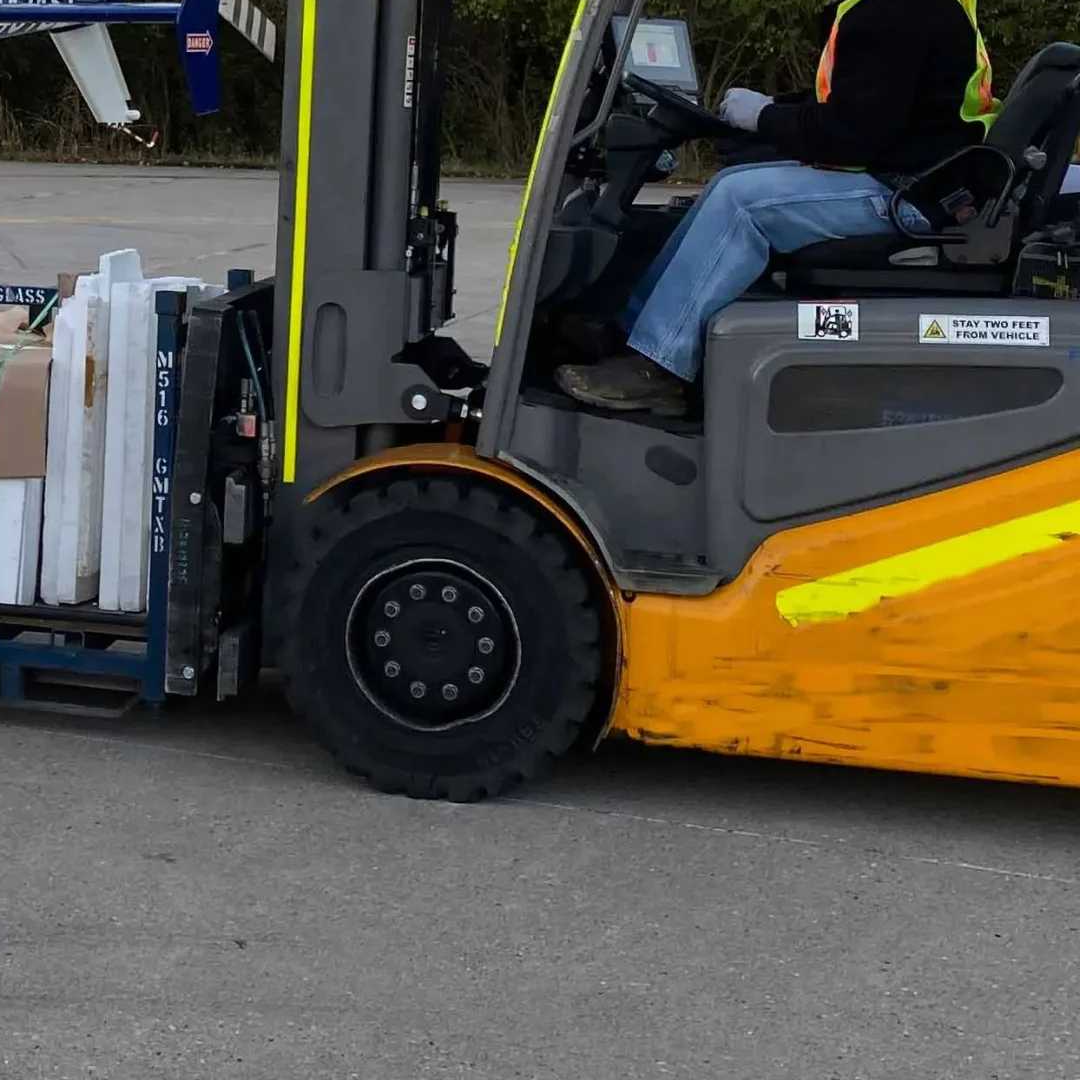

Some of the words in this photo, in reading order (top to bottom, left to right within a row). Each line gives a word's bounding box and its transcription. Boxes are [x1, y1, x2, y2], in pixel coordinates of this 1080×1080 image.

[952, 319, 980, 328] STAY
[982, 320, 1009, 329] TWO
[1012, 321, 1041, 329] FEET
[956, 330, 988, 339] FROM
[990, 331, 1040, 340] VEHICLE
[157, 351, 173, 426] M516
[153, 457, 169, 552] GMTXB
